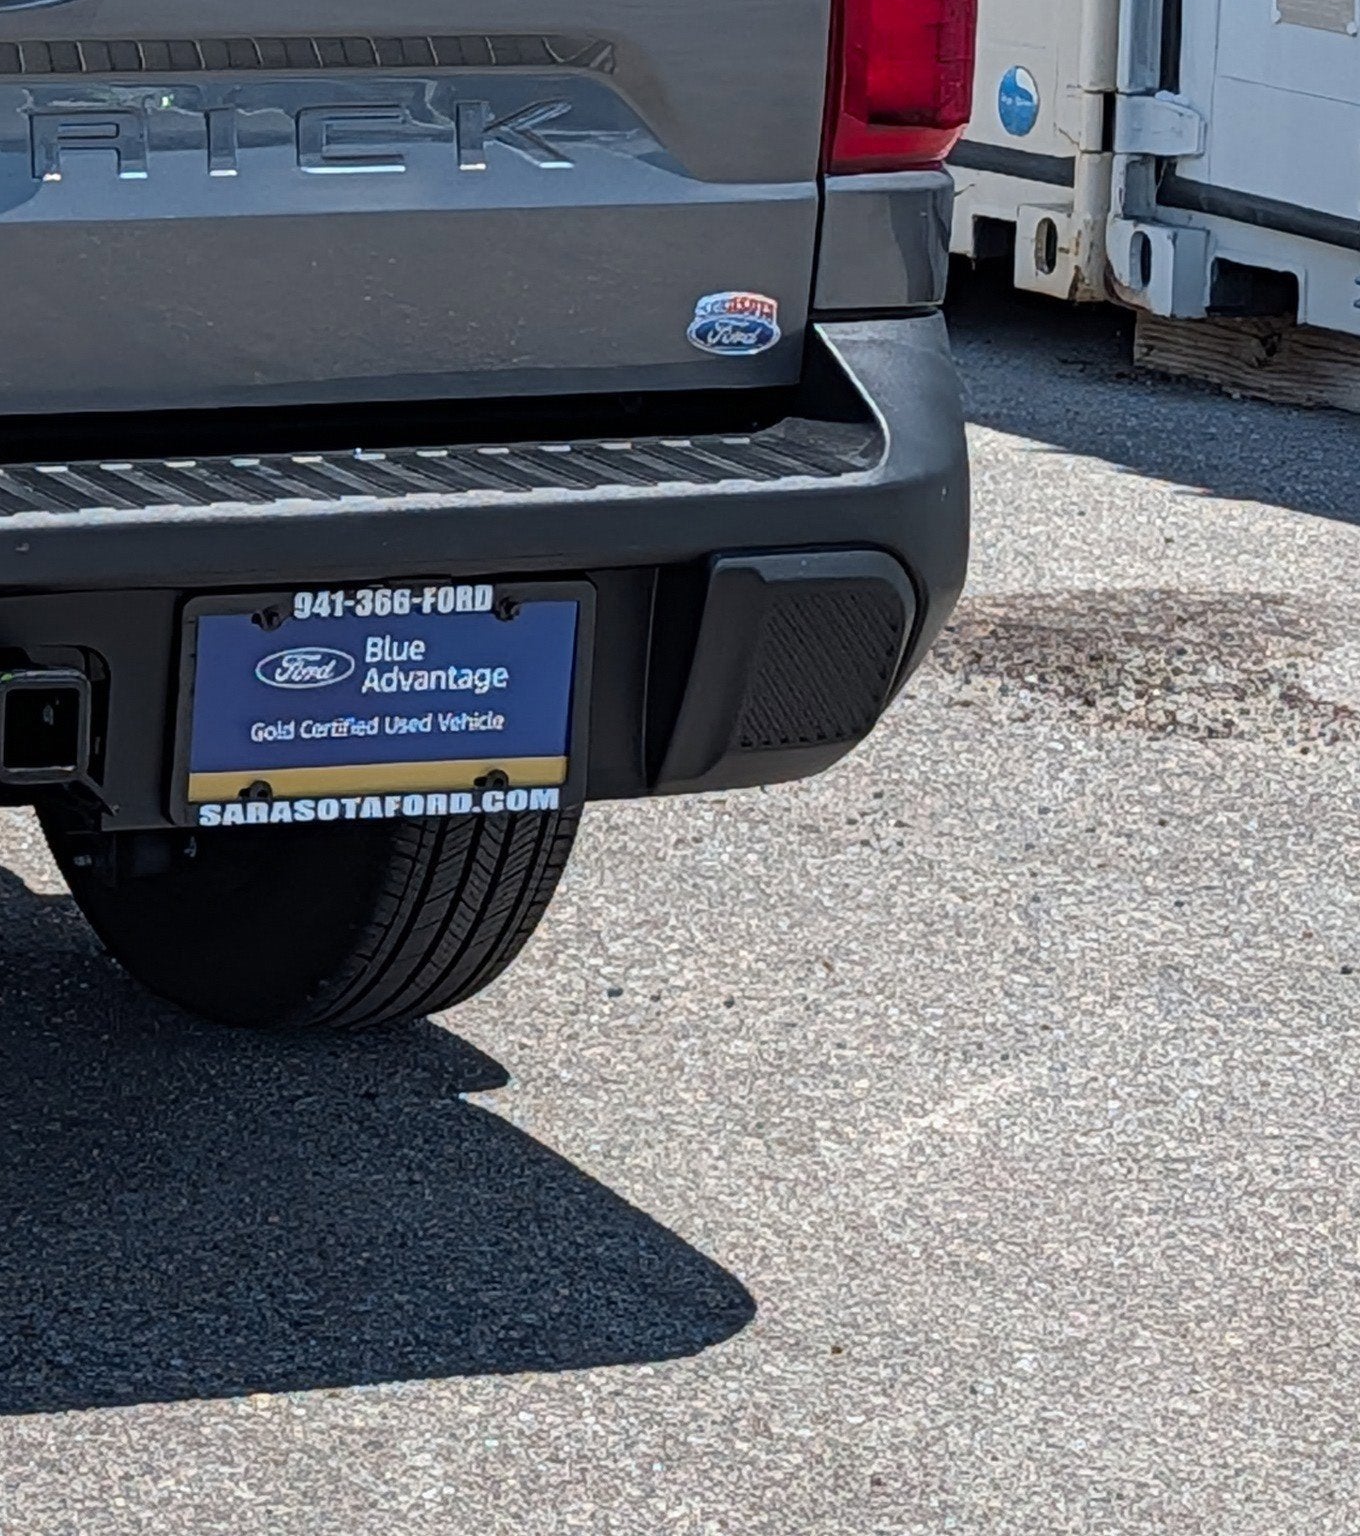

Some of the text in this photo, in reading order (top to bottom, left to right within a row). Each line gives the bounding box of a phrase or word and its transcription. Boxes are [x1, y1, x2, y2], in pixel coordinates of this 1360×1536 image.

[293, 585, 495, 620] 941-366-FORD
[364, 635, 427, 664] Blue
[273, 653, 338, 684] Ford
[360, 664, 510, 695] Advantage
[250, 711, 506, 742] Gold Certified Used Vehicle
[198, 788, 561, 827] SARASOTAFORD.COM
